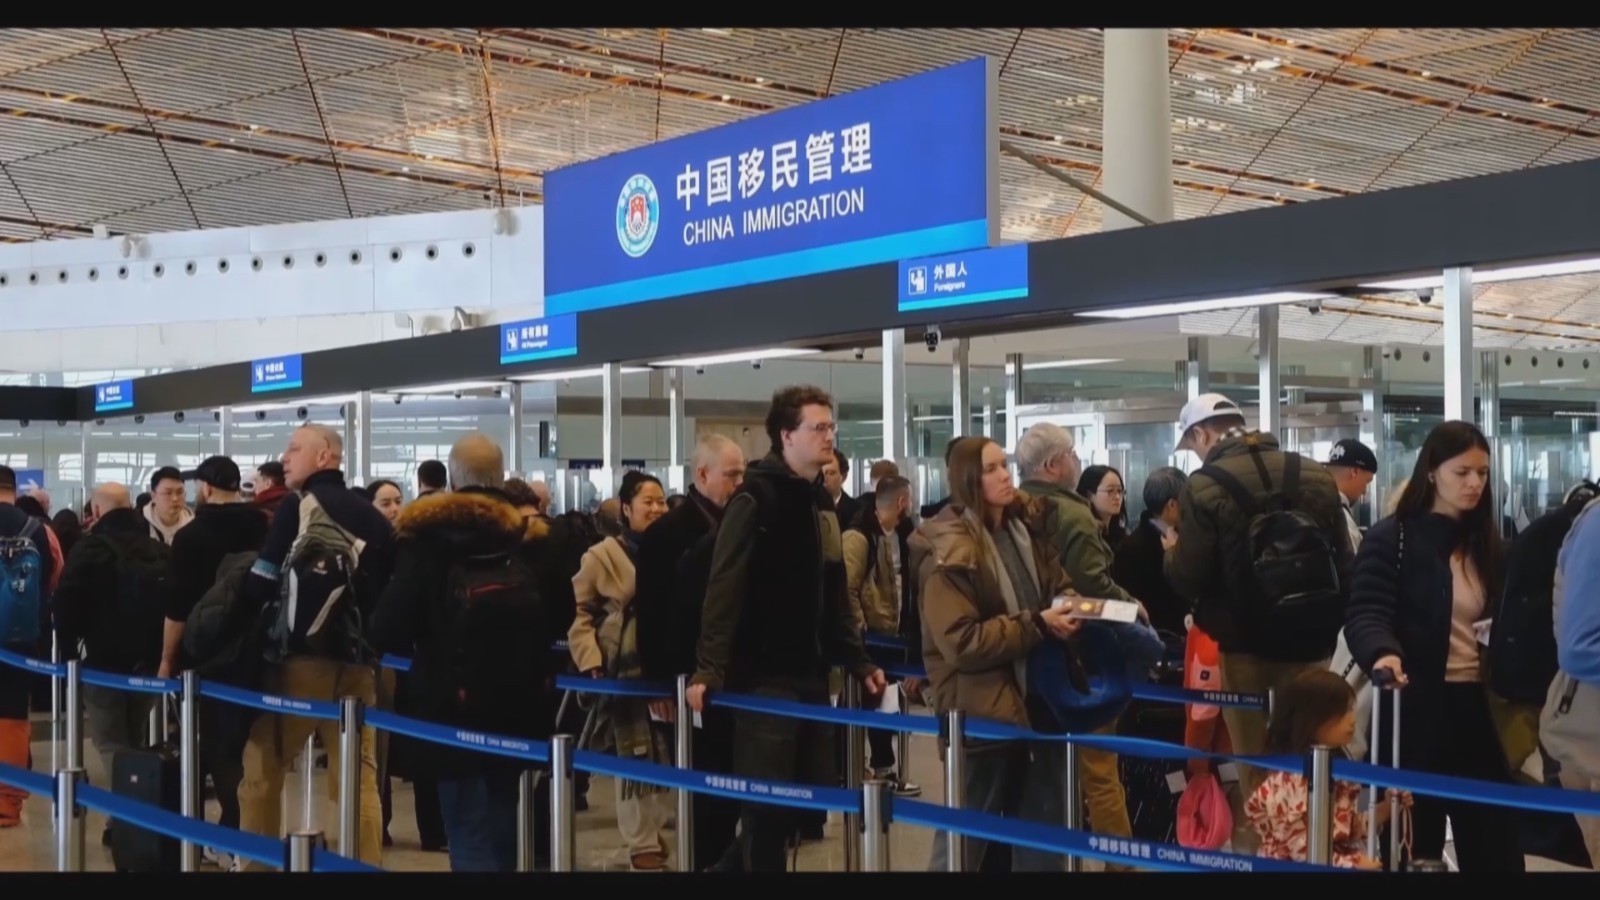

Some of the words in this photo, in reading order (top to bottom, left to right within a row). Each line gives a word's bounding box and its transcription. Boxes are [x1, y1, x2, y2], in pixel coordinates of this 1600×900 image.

[676, 121, 873, 212] 中国移民管理
[683, 214, 735, 247] CHINA
[743, 187, 865, 235] IMMIGRATION
[933, 261, 968, 280] 外国人
[1088, 835, 1151, 859] 中国移民管理
[1157, 847, 1186, 863] CHINA
[1189, 852, 1253, 872] IMMIGRATION
